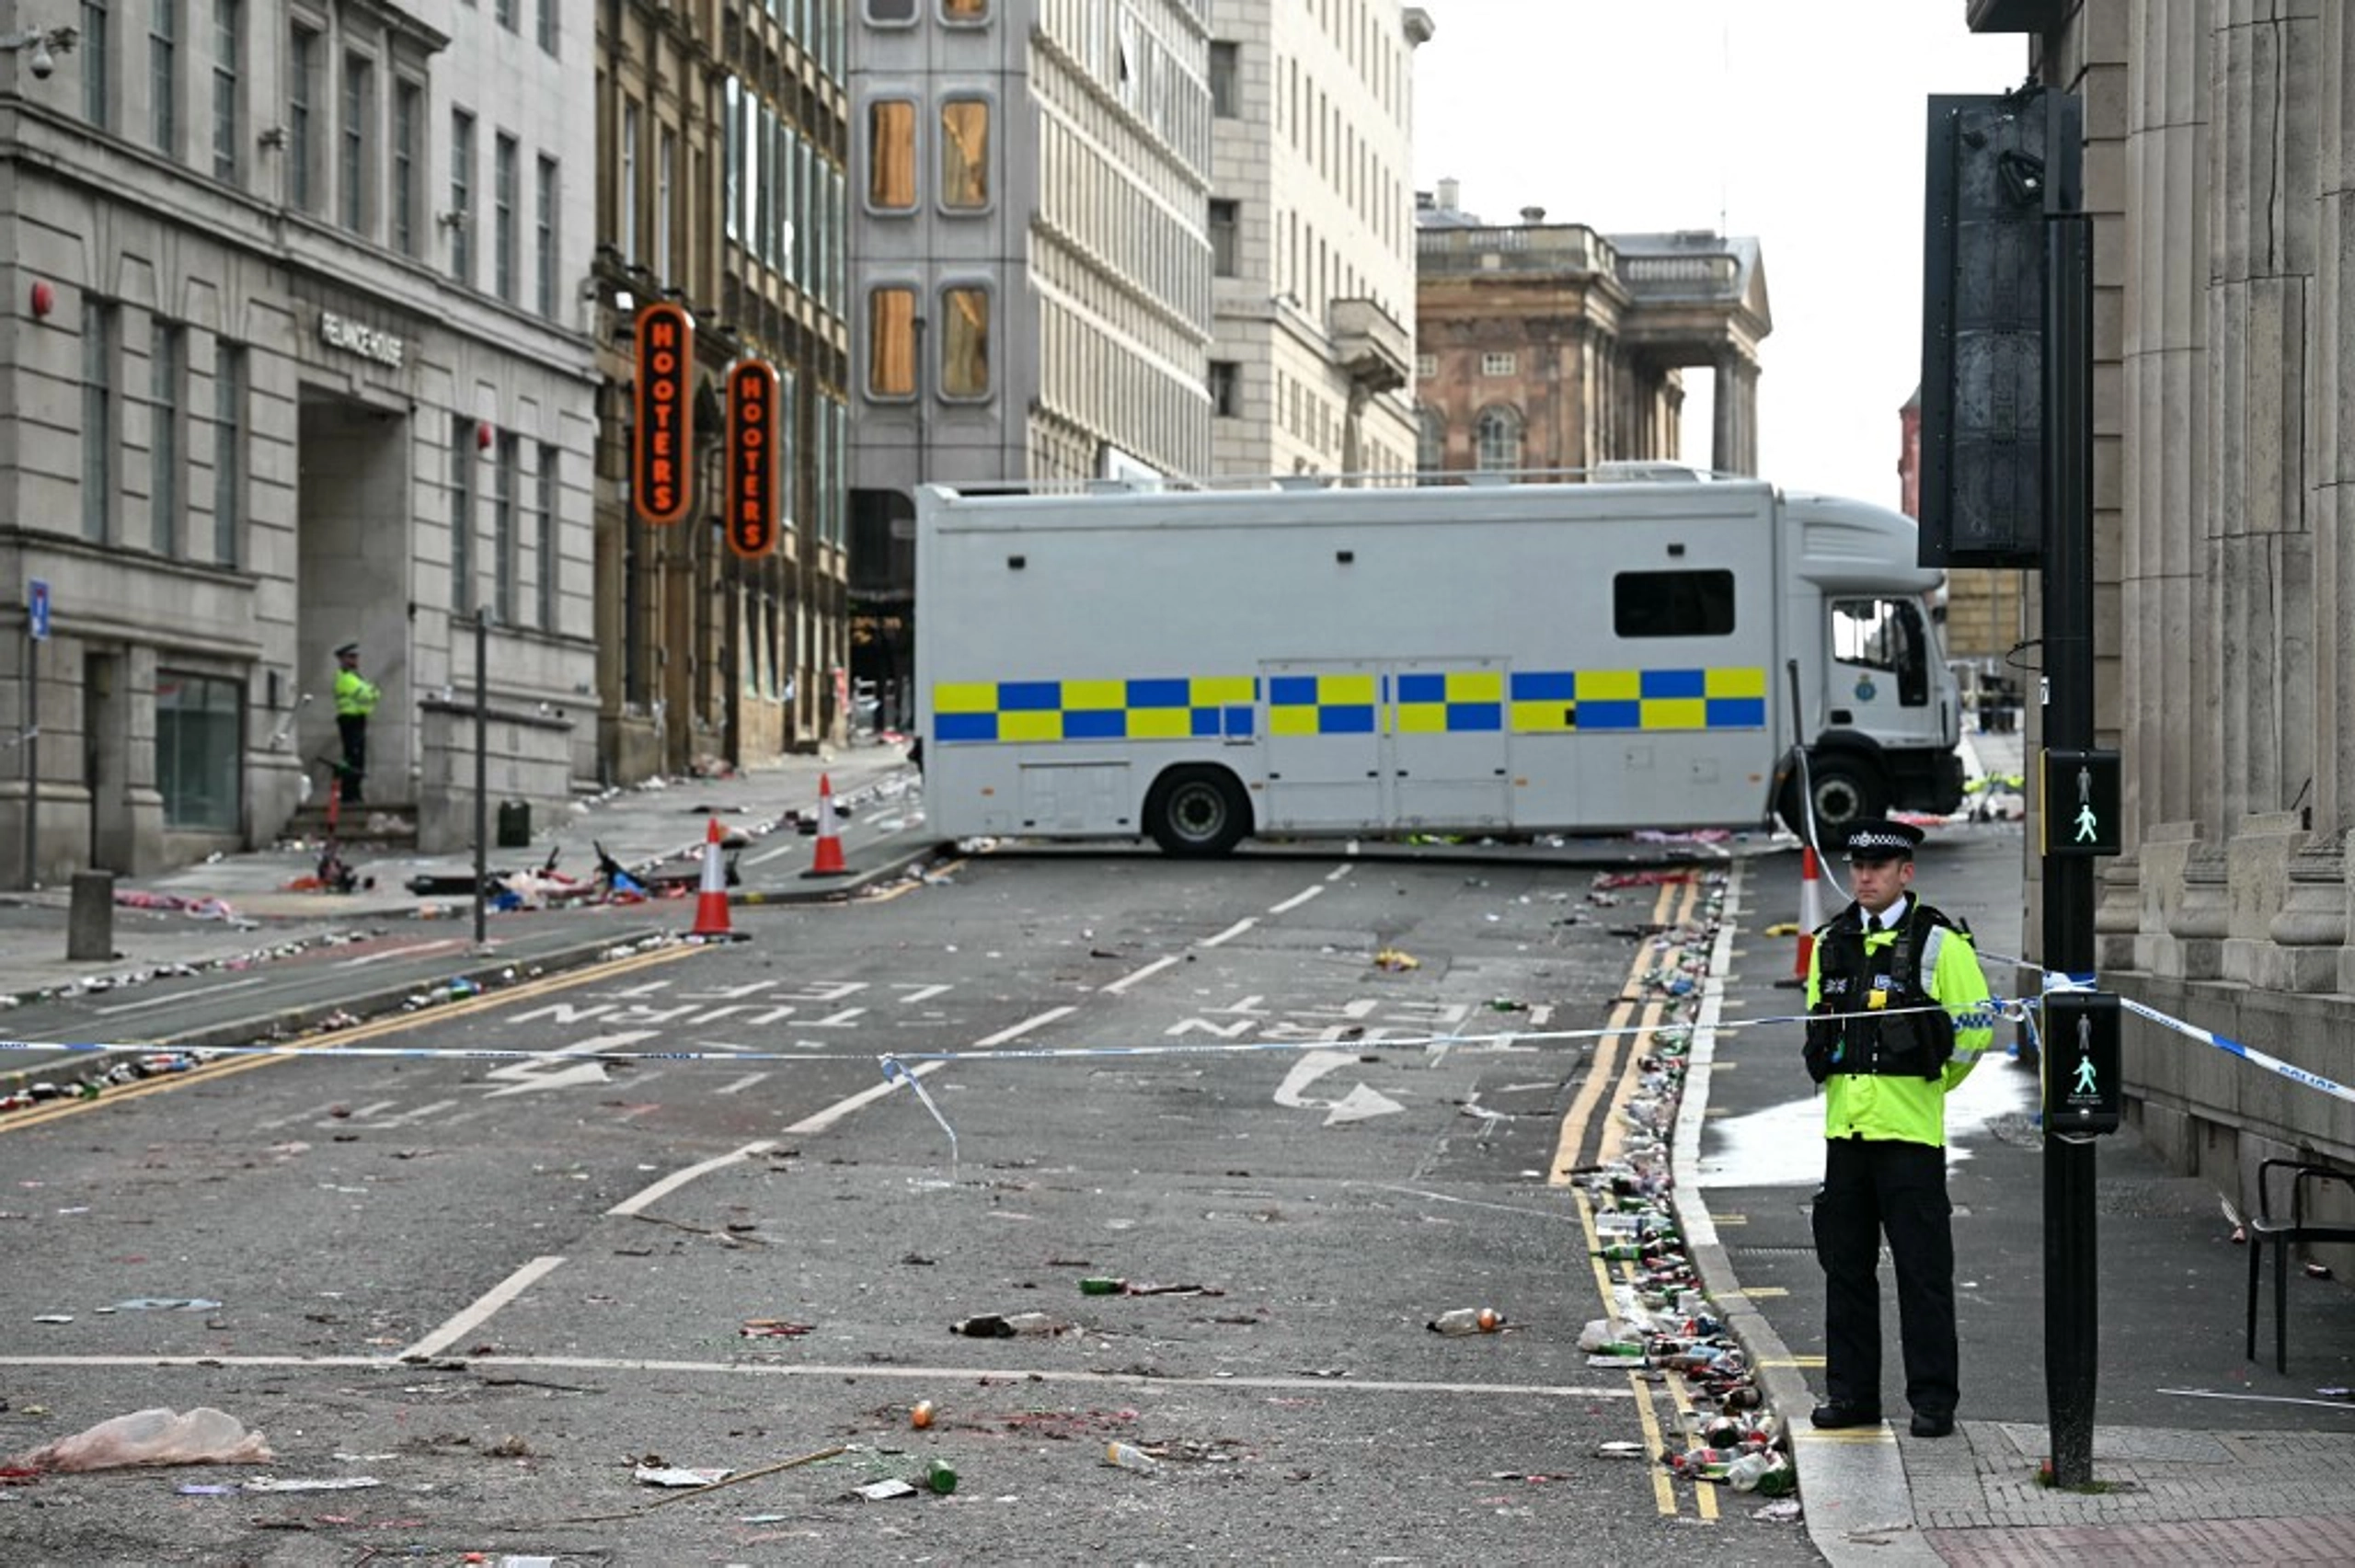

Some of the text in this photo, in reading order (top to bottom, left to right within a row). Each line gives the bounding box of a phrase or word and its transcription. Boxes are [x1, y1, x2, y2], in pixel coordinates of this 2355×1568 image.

[651, 323, 675, 510] HOOTERS
[741, 376, 763, 546] HOOTERS
[504, 1003, 867, 1027] TURN
